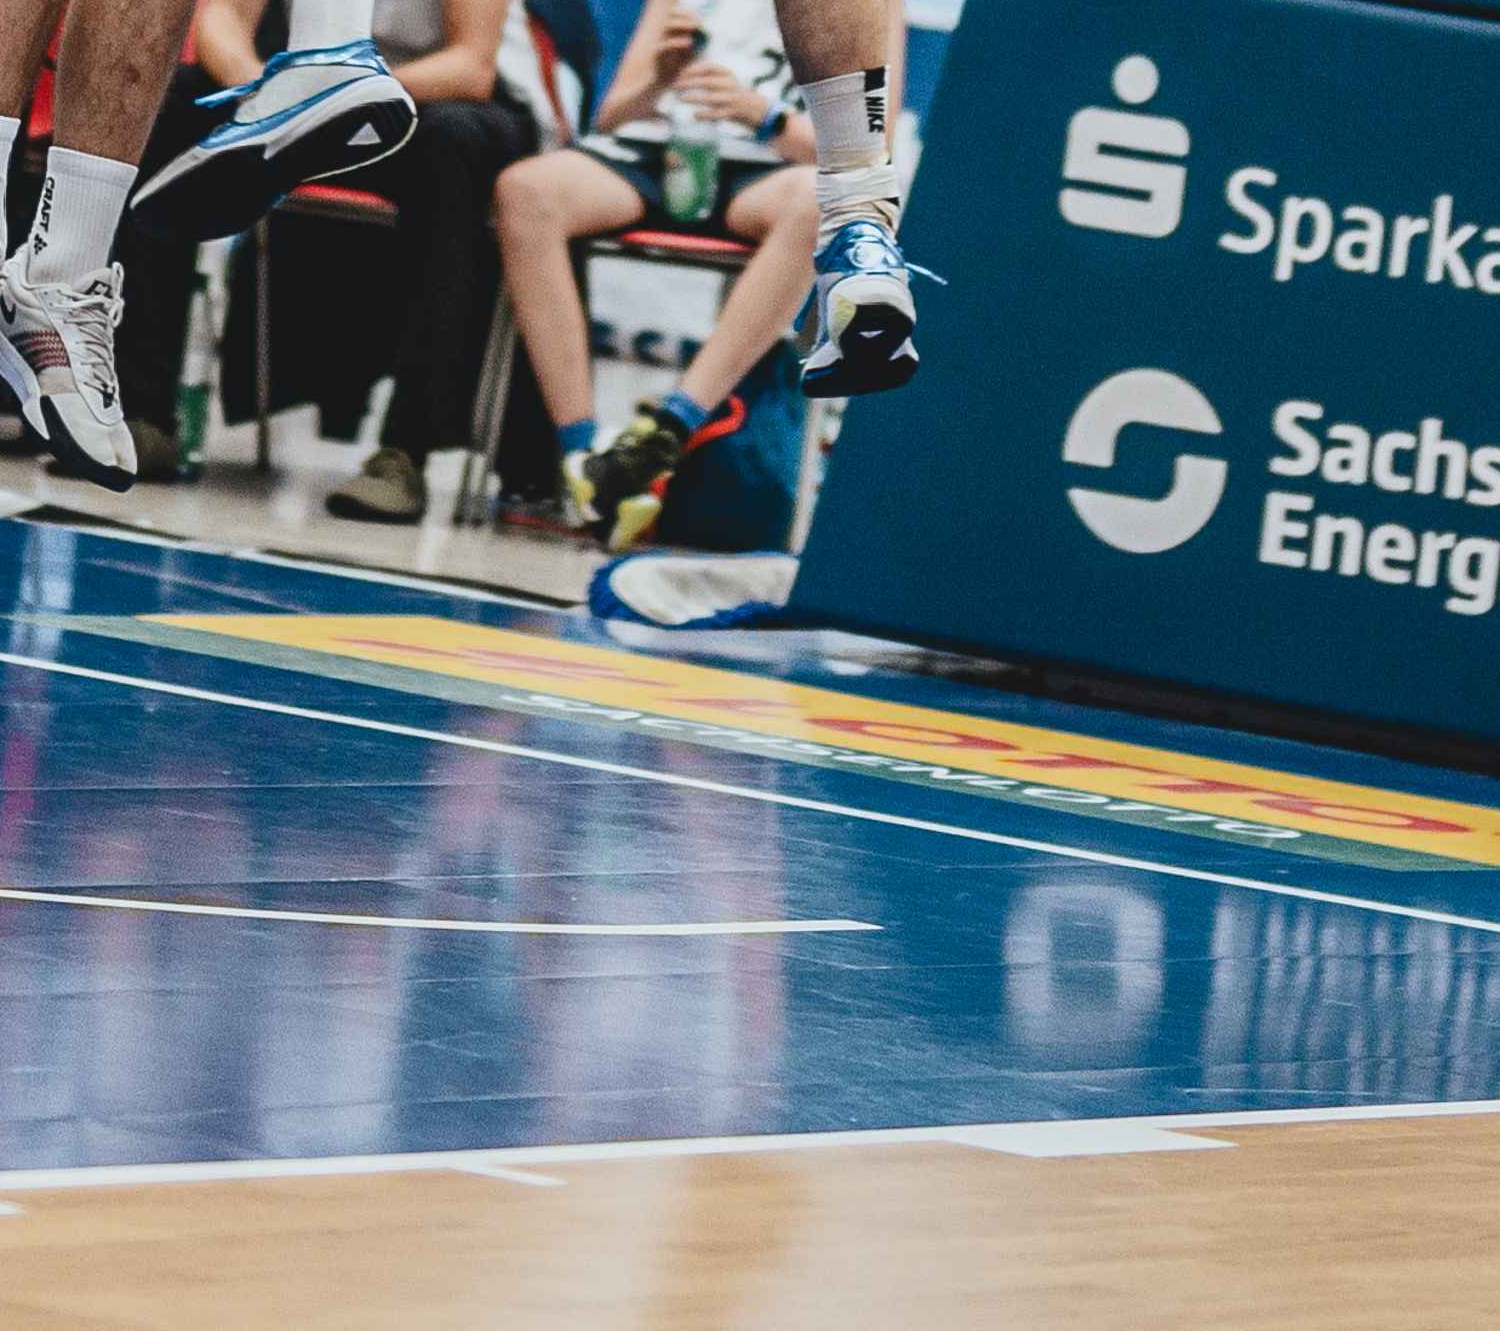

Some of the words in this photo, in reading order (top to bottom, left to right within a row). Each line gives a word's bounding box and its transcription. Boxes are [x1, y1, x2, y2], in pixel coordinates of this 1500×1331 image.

[38, 176, 56, 233] CRAFT
[497, 692, 1310, 839] SACHSENLOTTO
[666, 694, 1474, 834] LOTTO
